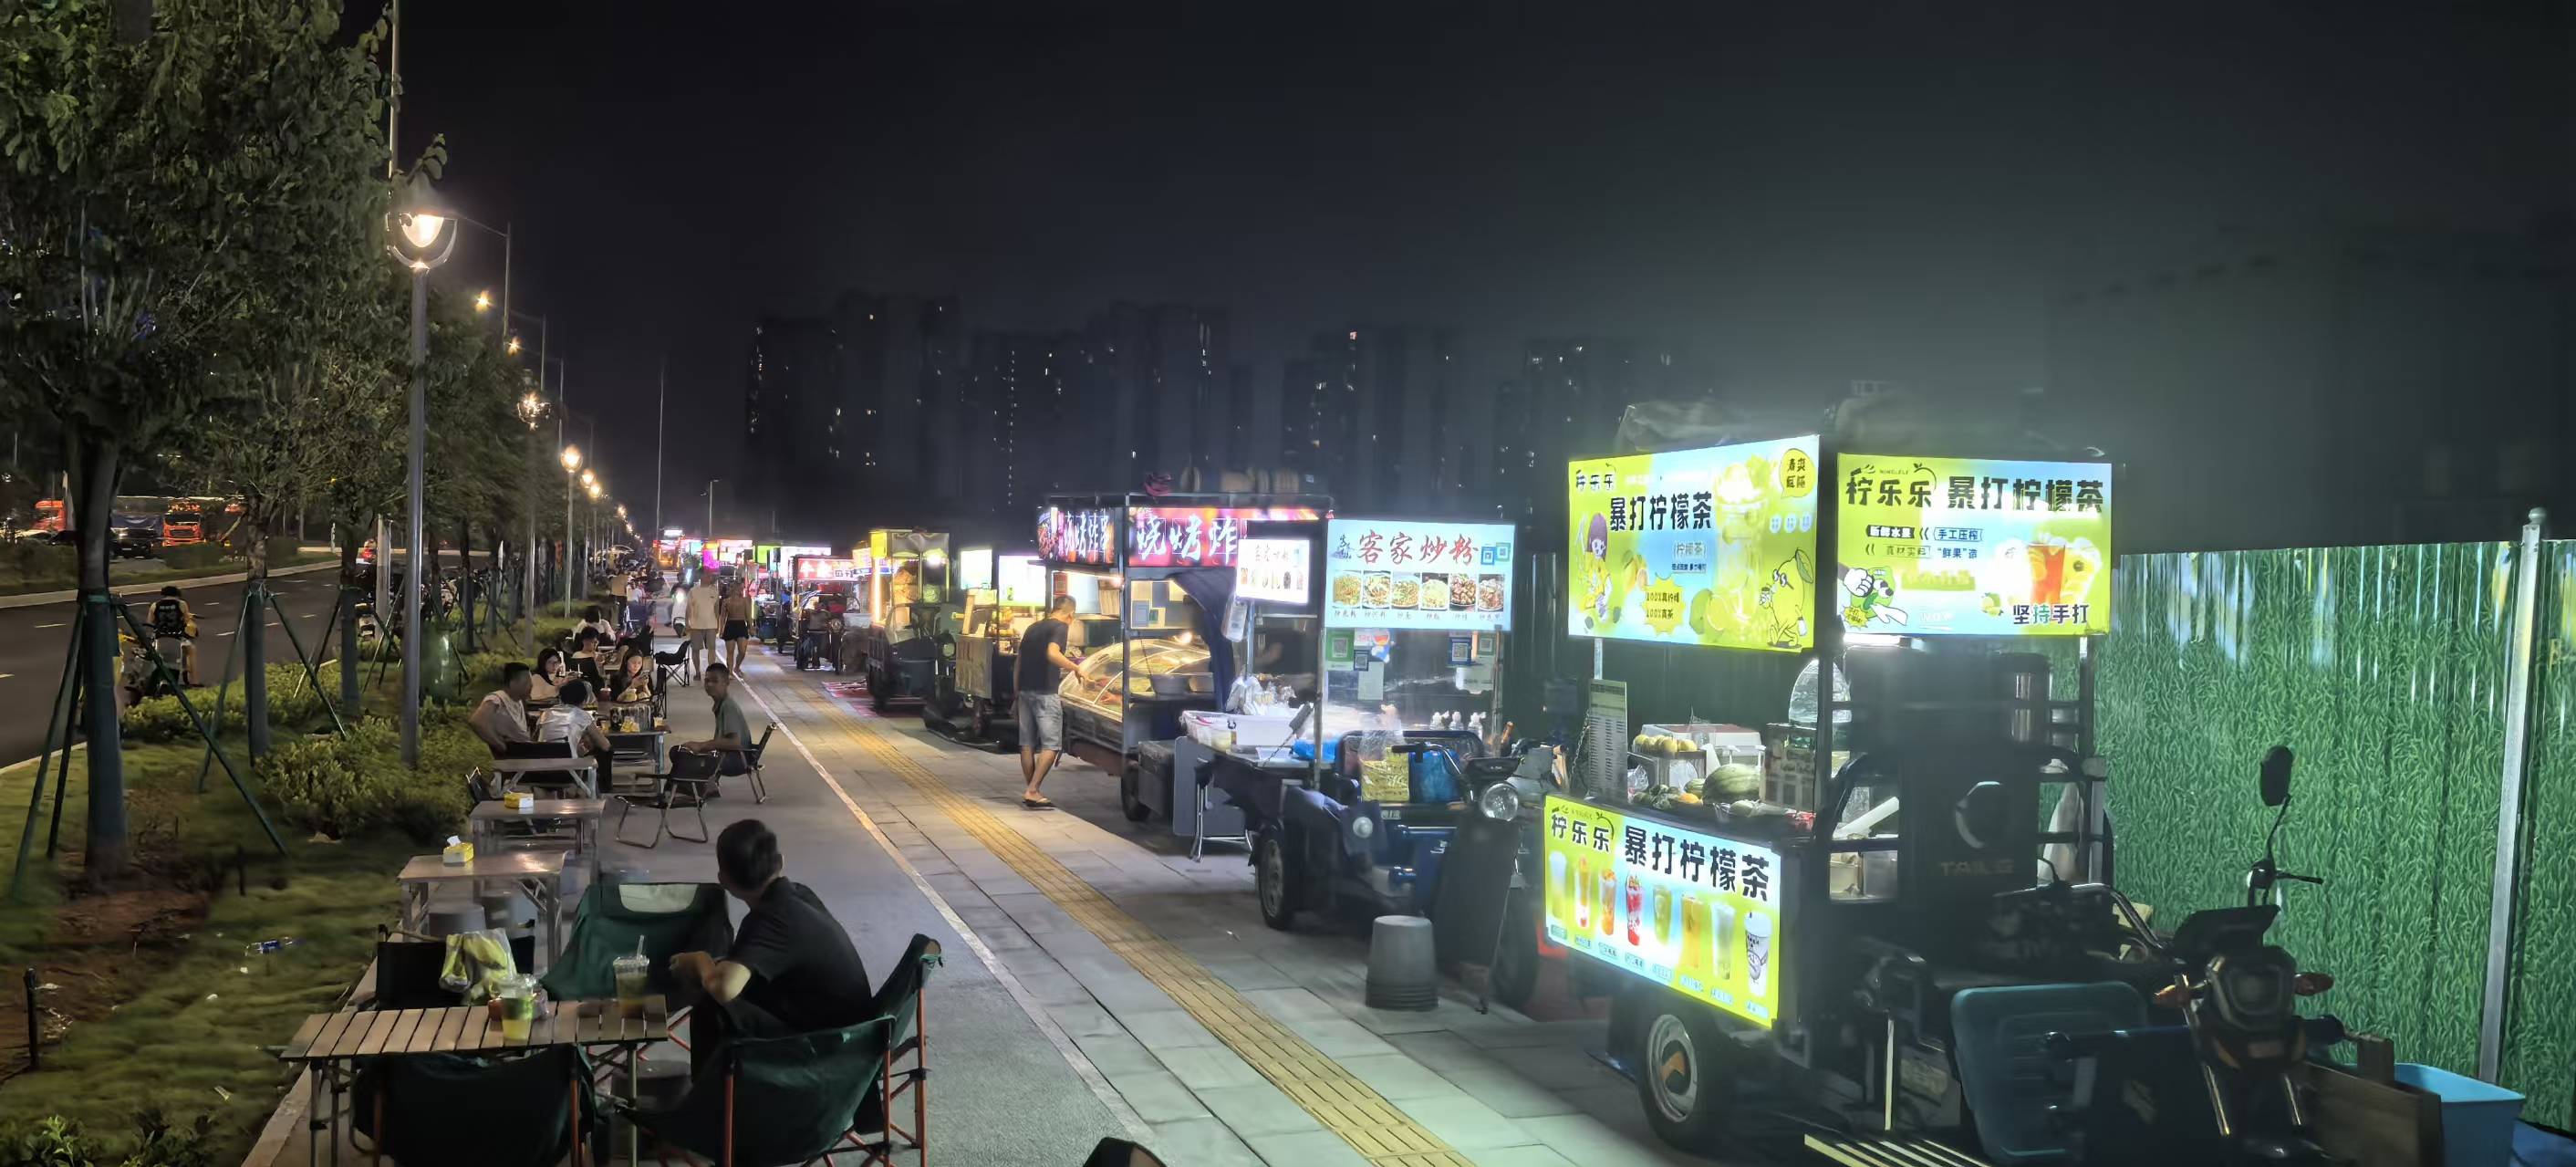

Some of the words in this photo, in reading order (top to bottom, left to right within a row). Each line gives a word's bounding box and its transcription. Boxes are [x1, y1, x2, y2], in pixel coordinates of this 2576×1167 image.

[1845, 468, 1932, 507] 柠乐乐
[1948, 475, 2103, 513] 暴打柠檬茶
[1610, 491, 1712, 531] 暴打柠檬茶
[1137, 513, 1248, 564] 烧烤炸
[1357, 529, 1480, 565] 客家炒粉
[2013, 603, 2090, 625] 坚持手打
[1551, 813, 1610, 852] 柠乐乐
[1625, 825, 1770, 901] 暴打柠檬茶
